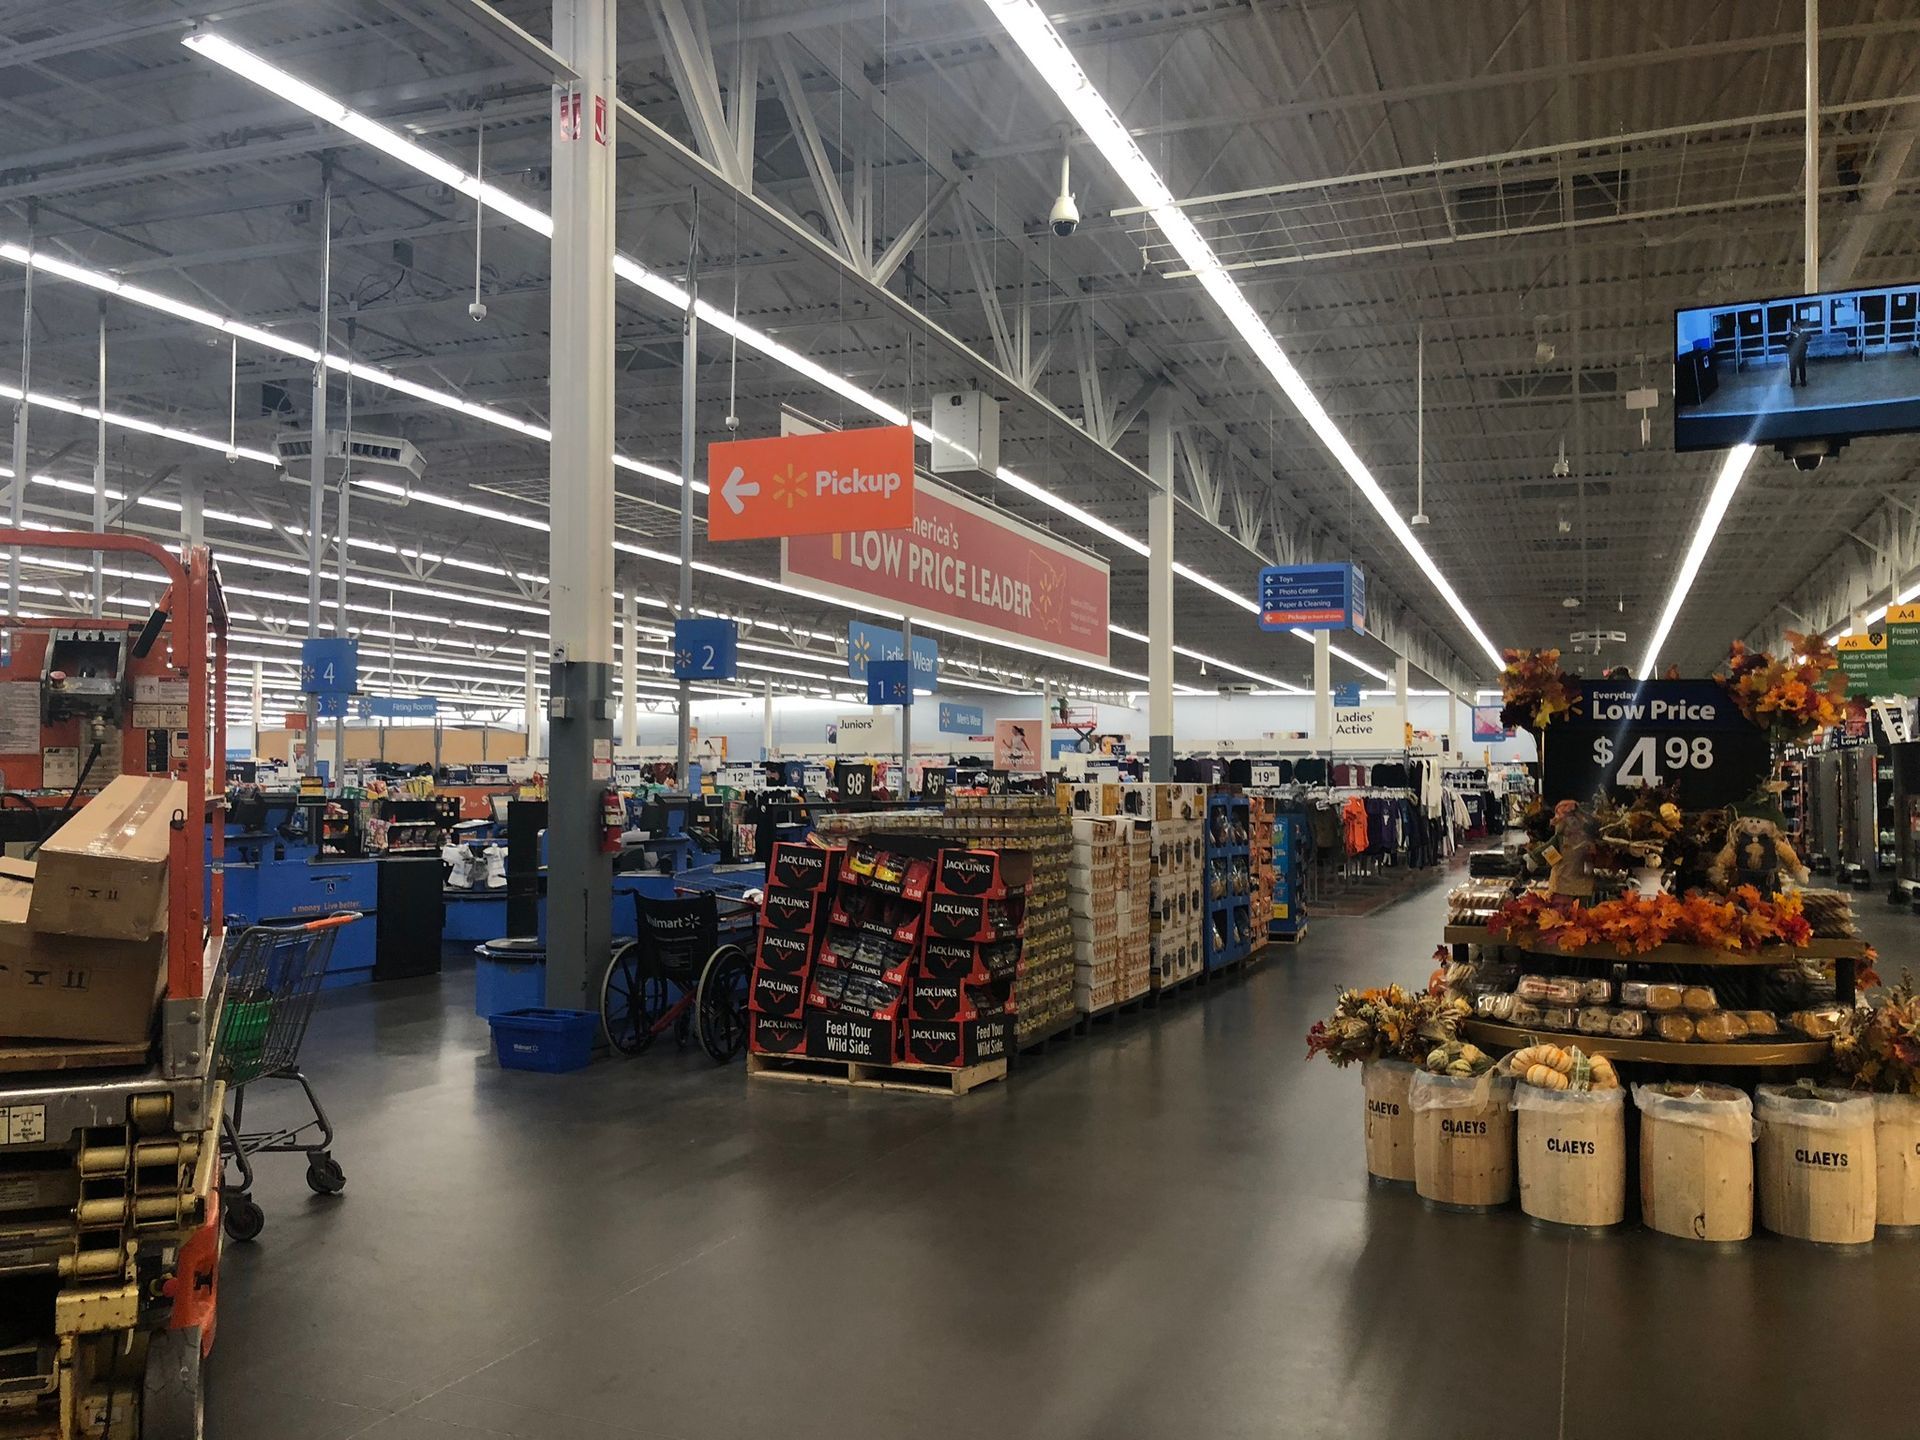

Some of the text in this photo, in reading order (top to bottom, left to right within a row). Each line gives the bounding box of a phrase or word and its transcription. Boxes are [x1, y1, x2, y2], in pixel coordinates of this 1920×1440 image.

[815, 468, 900, 498] Pickup
[910, 514, 959, 550] merica's
[850, 530, 901, 579] LOW
[909, 543, 967, 599] PRICE
[971, 563, 1032, 619] LEADER
[1279, 587, 1319, 596] Photo Center
[1279, 601, 1297, 609] Paper
[1303, 599, 1331, 608] Cleaning
[1899, 609, 1915, 619] A4
[1844, 640, 1858, 648] A6
[702, 645, 715, 671] 2
[912, 650, 934, 673] Wear
[323, 662, 335, 685] 4
[878, 680, 885, 699] 1
[1593, 691, 1637, 701] Everyday
[413, 703, 434, 711] Rooms
[1592, 699, 1716, 721] Low Price
[1336, 711, 1375, 722] Ladies'
[840, 719, 874, 730] Juniors'
[1336, 724, 1373, 734] Active
[1841, 737, 1858, 745] Low
[779, 854, 798, 865] JACK
[944, 859, 965, 871] JACK
[769, 894, 787, 906] JACK
[323, 902, 338, 910] Live
[933, 903, 954, 914] JACK
[764, 936, 783, 947] JACK
[928, 944, 948, 955] JACK
[851, 963, 865, 972] JACK
[758, 978, 777, 990] JACK
[915, 987, 935, 997] JACK
[840, 1003, 854, 1013] JACK
[758, 1019, 779, 1029] JACK
[826, 1020, 872, 1039] Feed Your
[911, 1029, 932, 1040] JACK
[976, 1023, 1004, 1040] Feed Your
[826, 1036, 872, 1056] Wild Side.
[977, 1041, 990, 1057] Wild
[1368, 1099, 1400, 1116] CLAEYS
[1441, 1119, 1487, 1135] CLAEYS
[1547, 1138, 1595, 1154] CLAEYS
[1795, 1149, 1849, 1166] CLAEYS
